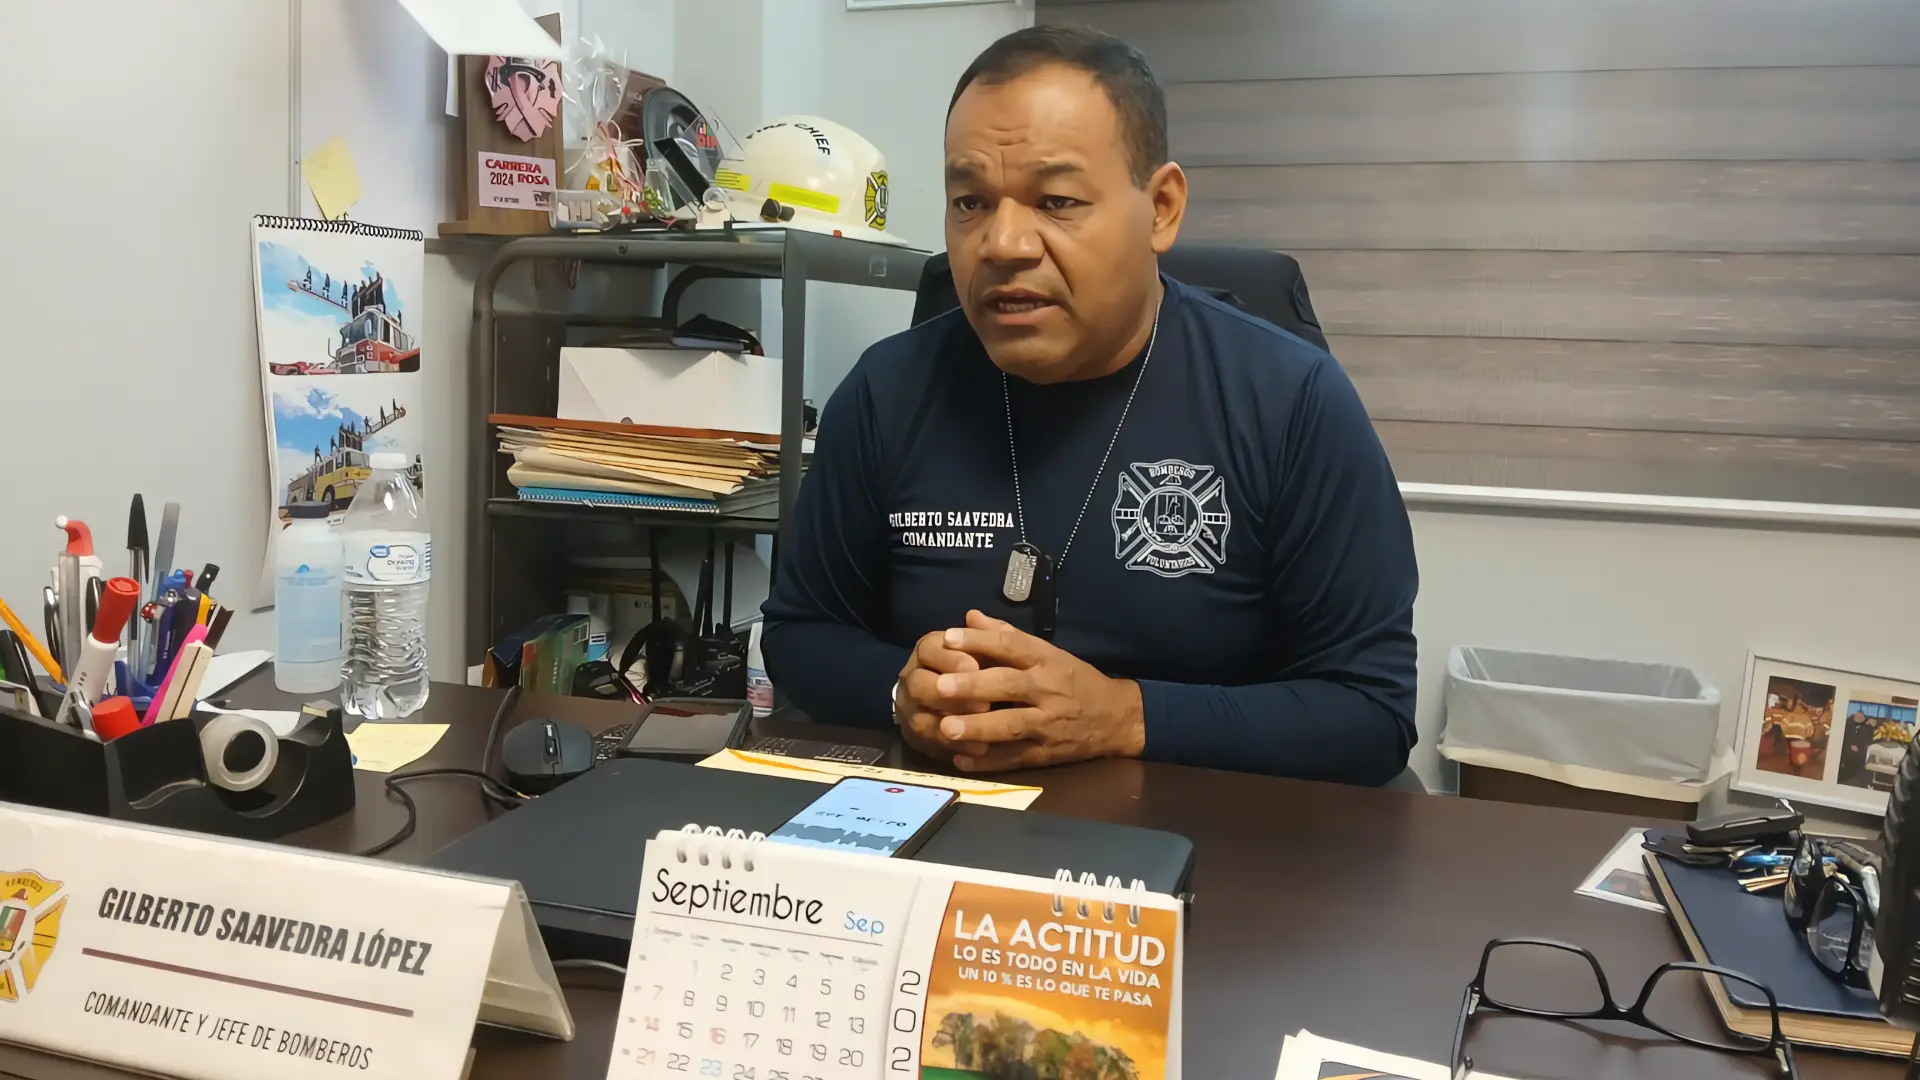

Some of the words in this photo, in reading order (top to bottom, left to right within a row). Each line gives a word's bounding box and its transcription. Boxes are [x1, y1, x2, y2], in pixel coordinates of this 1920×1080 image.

[794, 123, 831, 155] CHIEF
[485, 159, 541, 173] CARRERA
[490, 172, 514, 186] 2024
[517, 173, 550, 186] ROSA
[889, 511, 942, 527] GILBERTO
[947, 511, 1015, 528] SAAVEDRA
[902, 532, 994, 548] COMANDANTE
[652, 867, 823, 924] Septiembre
[843, 910, 885, 937] Sep
[98, 887, 215, 937] GILBERTO
[215, 908, 349, 962] SAAVEDRA
[351, 928, 433, 976] LÓPEZ
[954, 909, 999, 944] LA
[1009, 918, 1166, 967] ACTITUD
[720, 963, 733, 981] 2
[752, 968, 766, 986] 3
[786, 974, 798, 988] 4
[820, 978, 832, 996] 5
[854, 983, 867, 1001] 6
[953, 944, 977, 961] LO
[981, 948, 1001, 966] ES
[1006, 951, 1057, 973] TODO
[1061, 959, 1084, 977] EN
[1088, 963, 1112, 982] LA
[1117, 967, 1161, 989] VIDA
[958, 966, 979, 981] UN
[982, 970, 997, 984] 10
[1016, 974, 1032, 988] ES
[1036, 978, 1056, 992] LO
[1059, 981, 1090, 998] QUE
[1094, 985, 1111, 1000] TE
[1113, 987, 1153, 1007] PASA
[652, 984, 664, 1001] 7
[683, 989, 696, 1007] 8
[715, 994, 728, 1012] 9
[746, 1000, 765, 1018] 10
[783, 1005, 796, 1023] 11
[814, 1011, 831, 1029] 12
[847, 1016, 865, 1034] 13
[84, 991, 194, 1033] COMANDANTE
[196, 1013, 210, 1036] Y
[208, 1018, 250, 1045] JEFE
[251, 1025, 276, 1050] DE
[277, 1030, 373, 1070] BOMBEROS
[644, 1016, 660, 1032] 14
[677, 1021, 694, 1039] 15
[709, 1026, 727, 1045] 16
[743, 1032, 760, 1050] 17
[776, 1037, 793, 1056] 18
[810, 1043, 827, 1062] 19
[839, 1047, 864, 1068] 20
[636, 1047, 656, 1066] 21
[667, 1052, 690, 1072] 22
[700, 1058, 722, 1078] 23
[733, 1063, 756, 1080] 24
